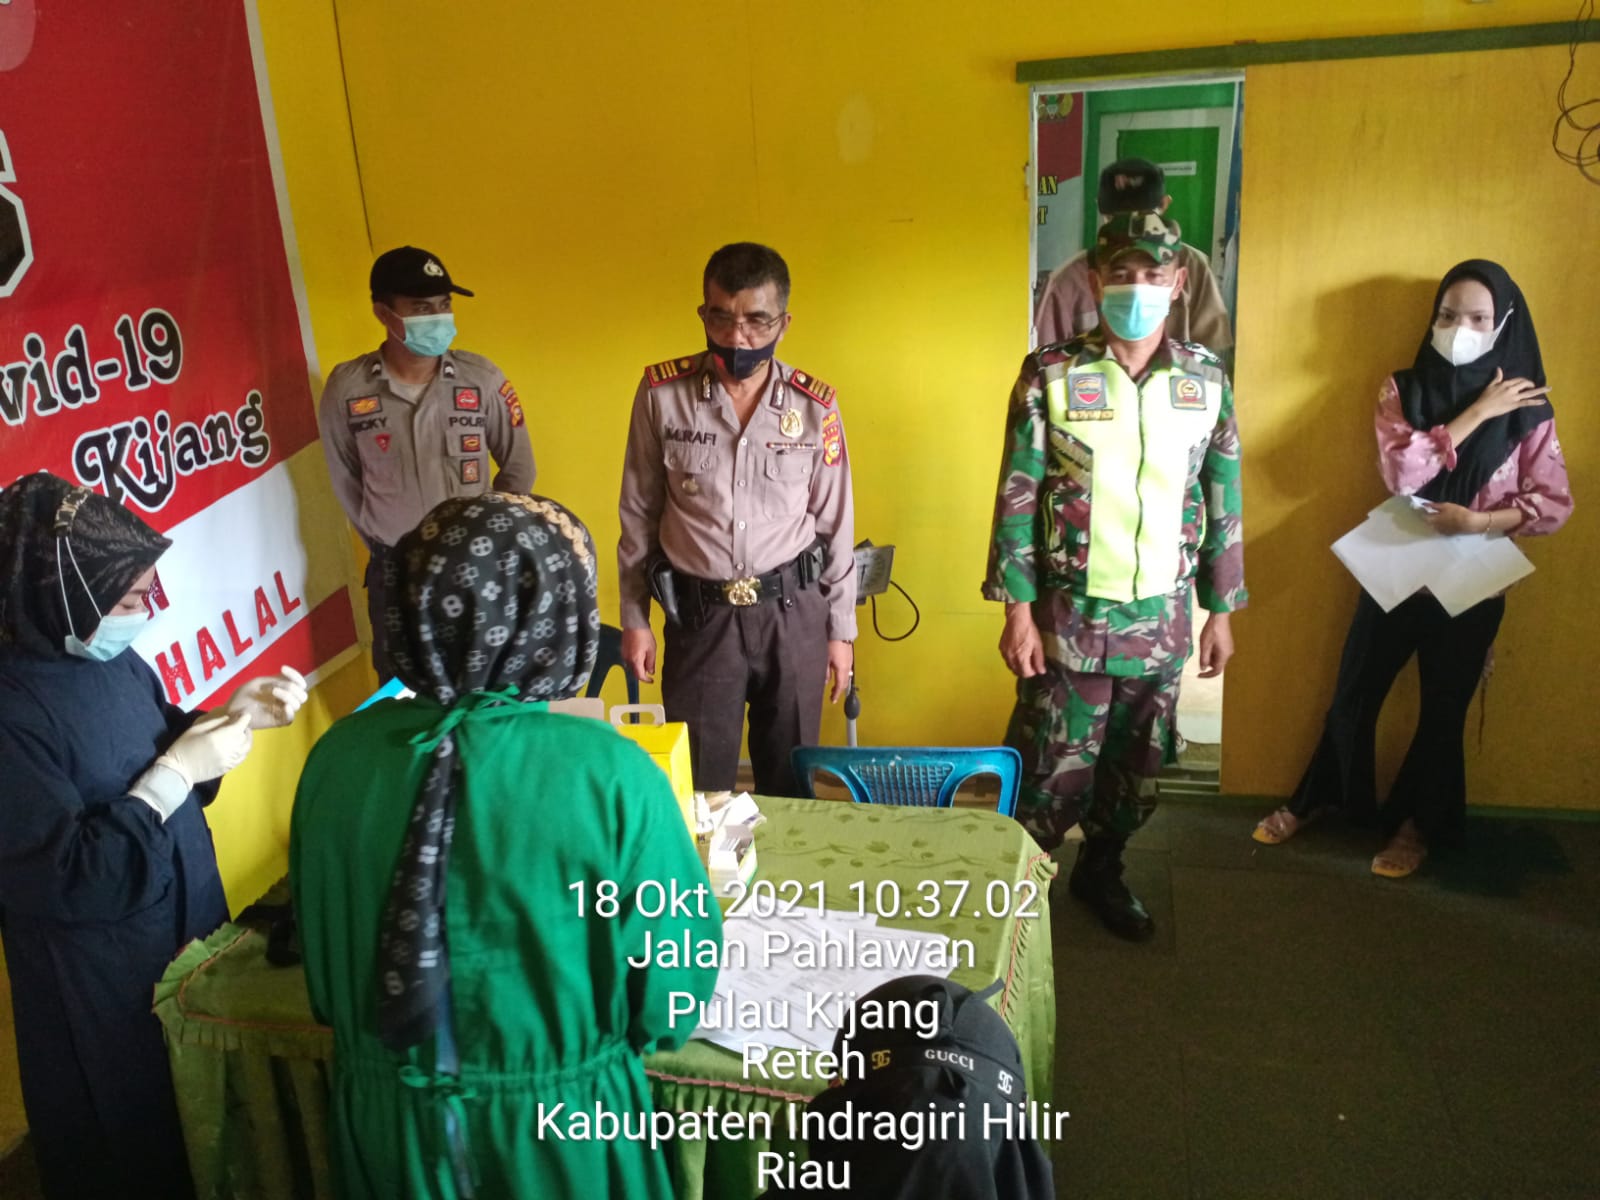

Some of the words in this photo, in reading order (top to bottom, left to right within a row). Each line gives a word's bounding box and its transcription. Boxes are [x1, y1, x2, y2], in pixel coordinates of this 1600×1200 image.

[72, 389, 270, 513] Kijang
[155, 570, 302, 706] HALAL
[924, 1049, 975, 1072] GUCCI
